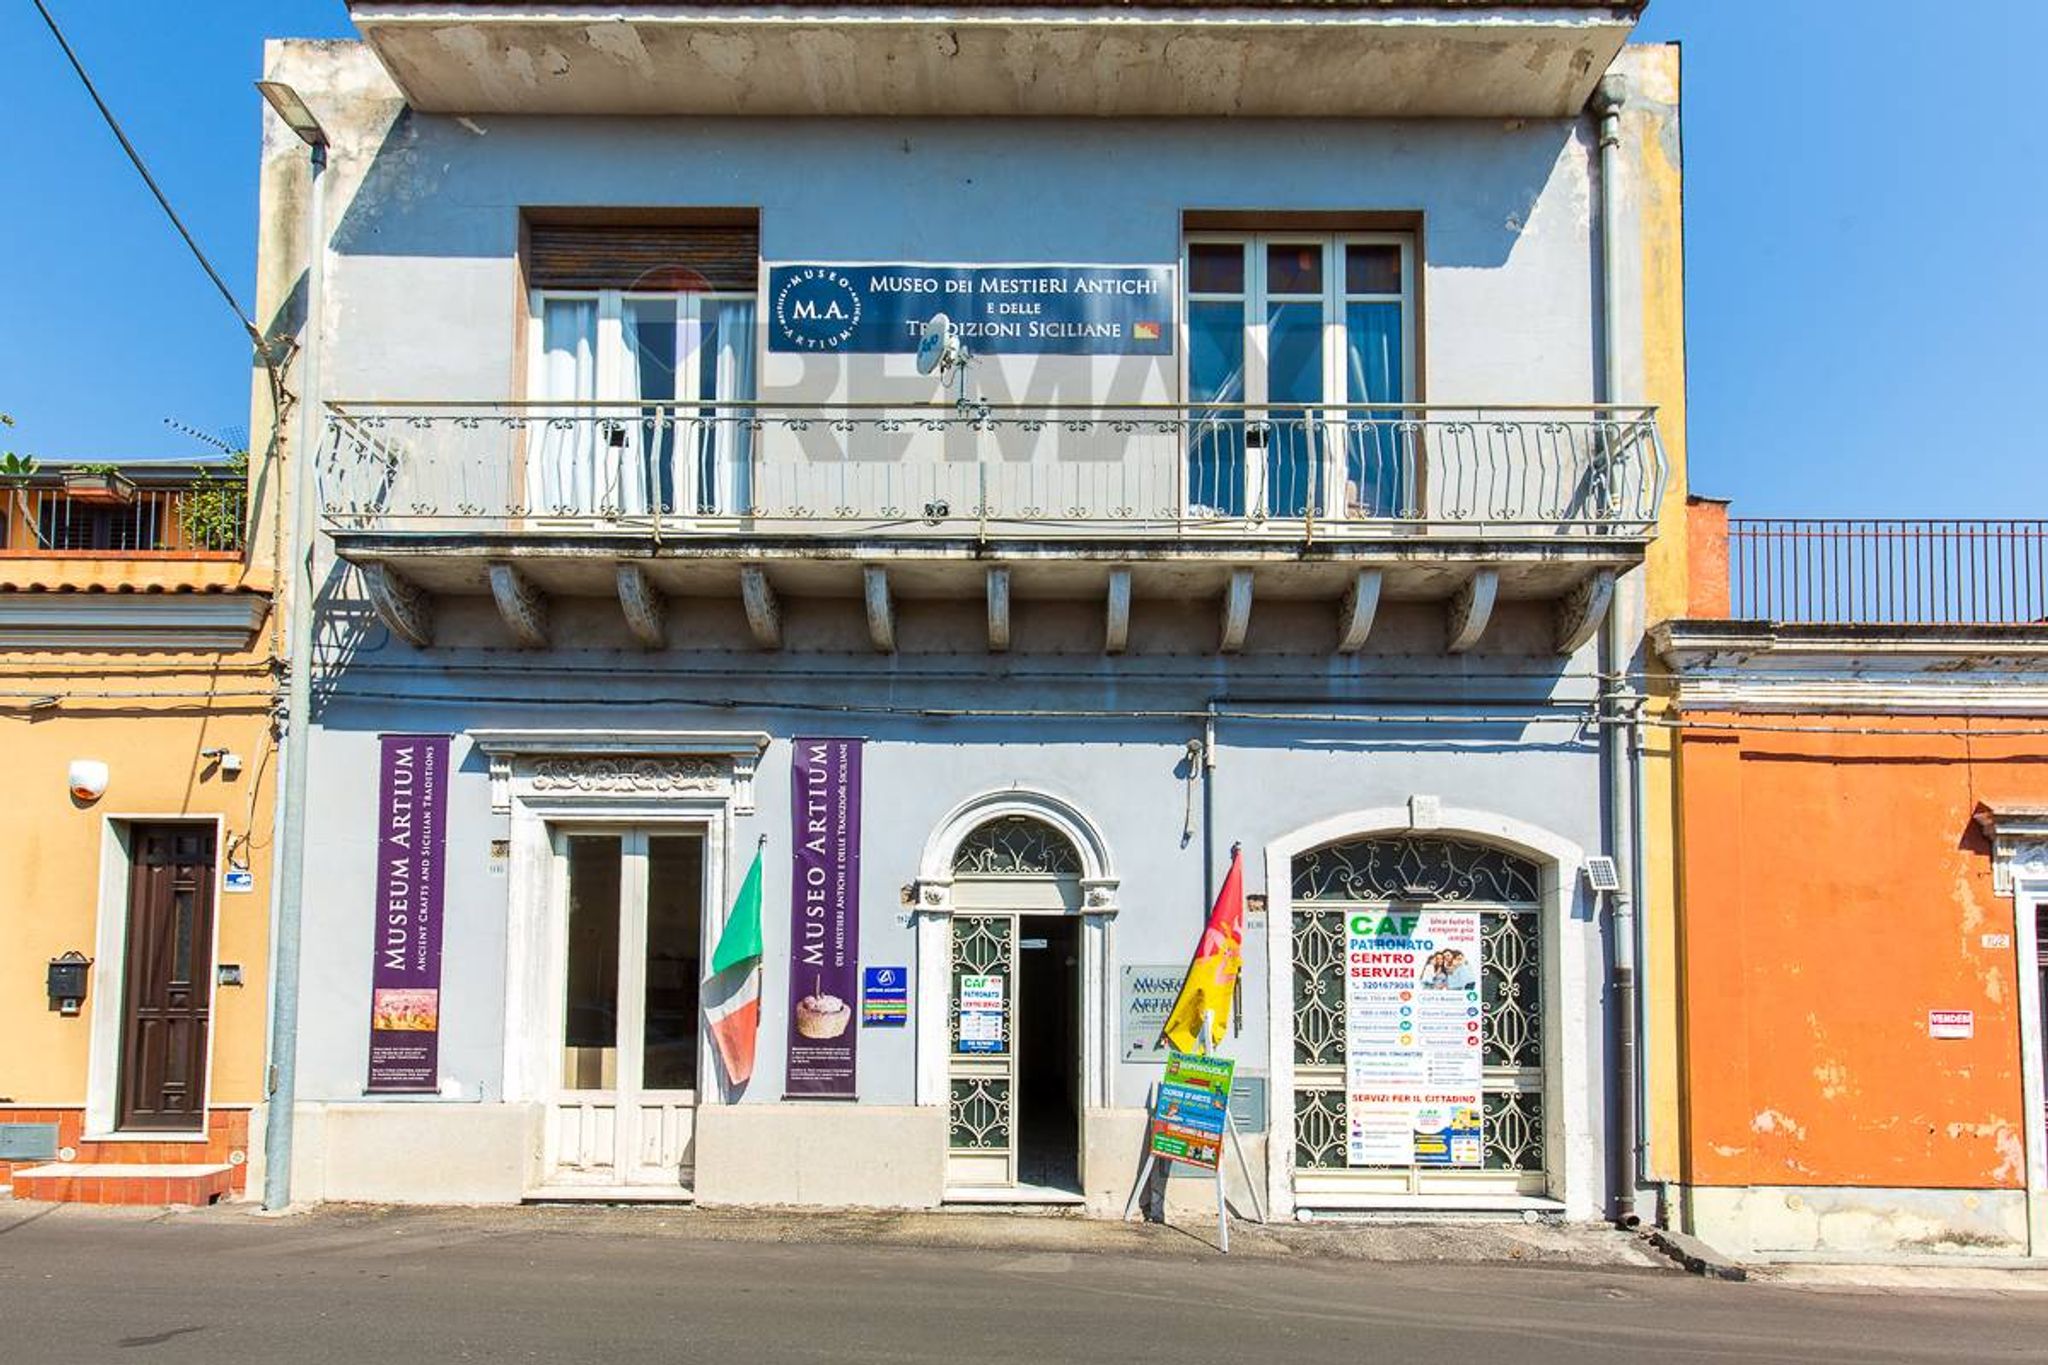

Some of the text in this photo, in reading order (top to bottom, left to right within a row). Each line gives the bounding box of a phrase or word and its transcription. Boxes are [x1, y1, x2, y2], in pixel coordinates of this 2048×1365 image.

[790, 269, 849, 288] MUSEO
[870, 276, 1157, 294] MUSEO DEI MESTIERI ANTICHI
[792, 300, 849, 319] M.A.
[986, 303, 1041, 314] E DELLE
[784, 328, 852, 349] ARTIUM
[905, 320, 1121, 338] TRDIZIONI SICILIANE
[384, 746, 414, 970] MUSEUM ARTIUM
[416, 746, 434, 972] ANCIENT CRAFTS AND SICILIAN TRADITIONS
[802, 744, 828, 966] MUSEO ARTIUM
[837, 838, 846, 862] DELLE
[836, 872, 846, 909] ANTICHI
[1350, 916, 1419, 935] CAF
[1350, 939, 1433, 950] PATRONATO
[1350, 953, 1414, 963] CENTRO
[1350, 967, 1415, 978] SERVIZI
[1352, 1094, 1476, 1104] SERVIZI PER IL CITTADINO
